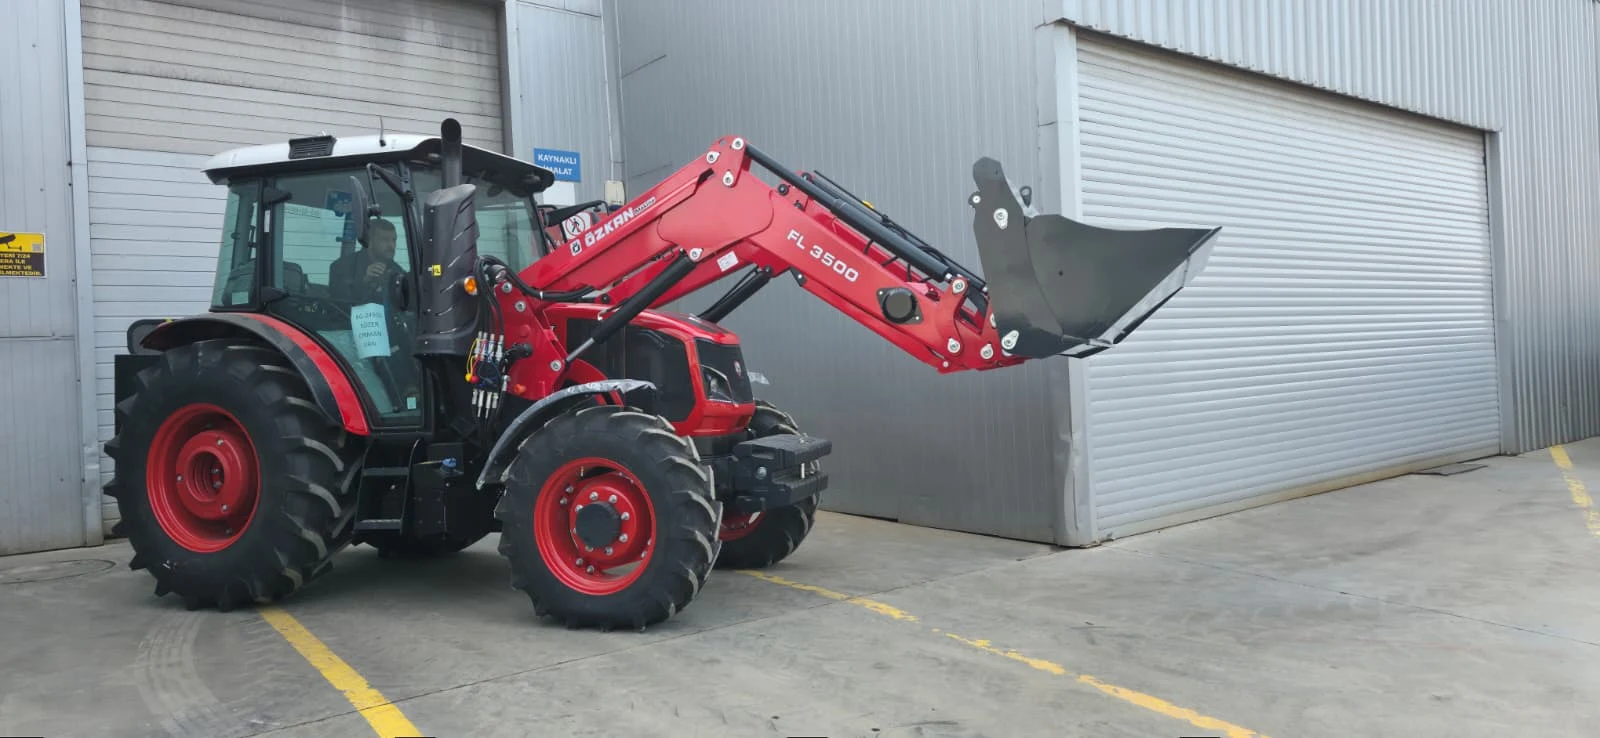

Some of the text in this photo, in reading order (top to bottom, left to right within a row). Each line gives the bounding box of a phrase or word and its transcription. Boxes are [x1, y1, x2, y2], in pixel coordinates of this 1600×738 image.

[537, 153, 577, 165] KAYNAKLI
[584, 207, 635, 248] ÖZKAN
[786, 229, 860, 283] FL 3500
